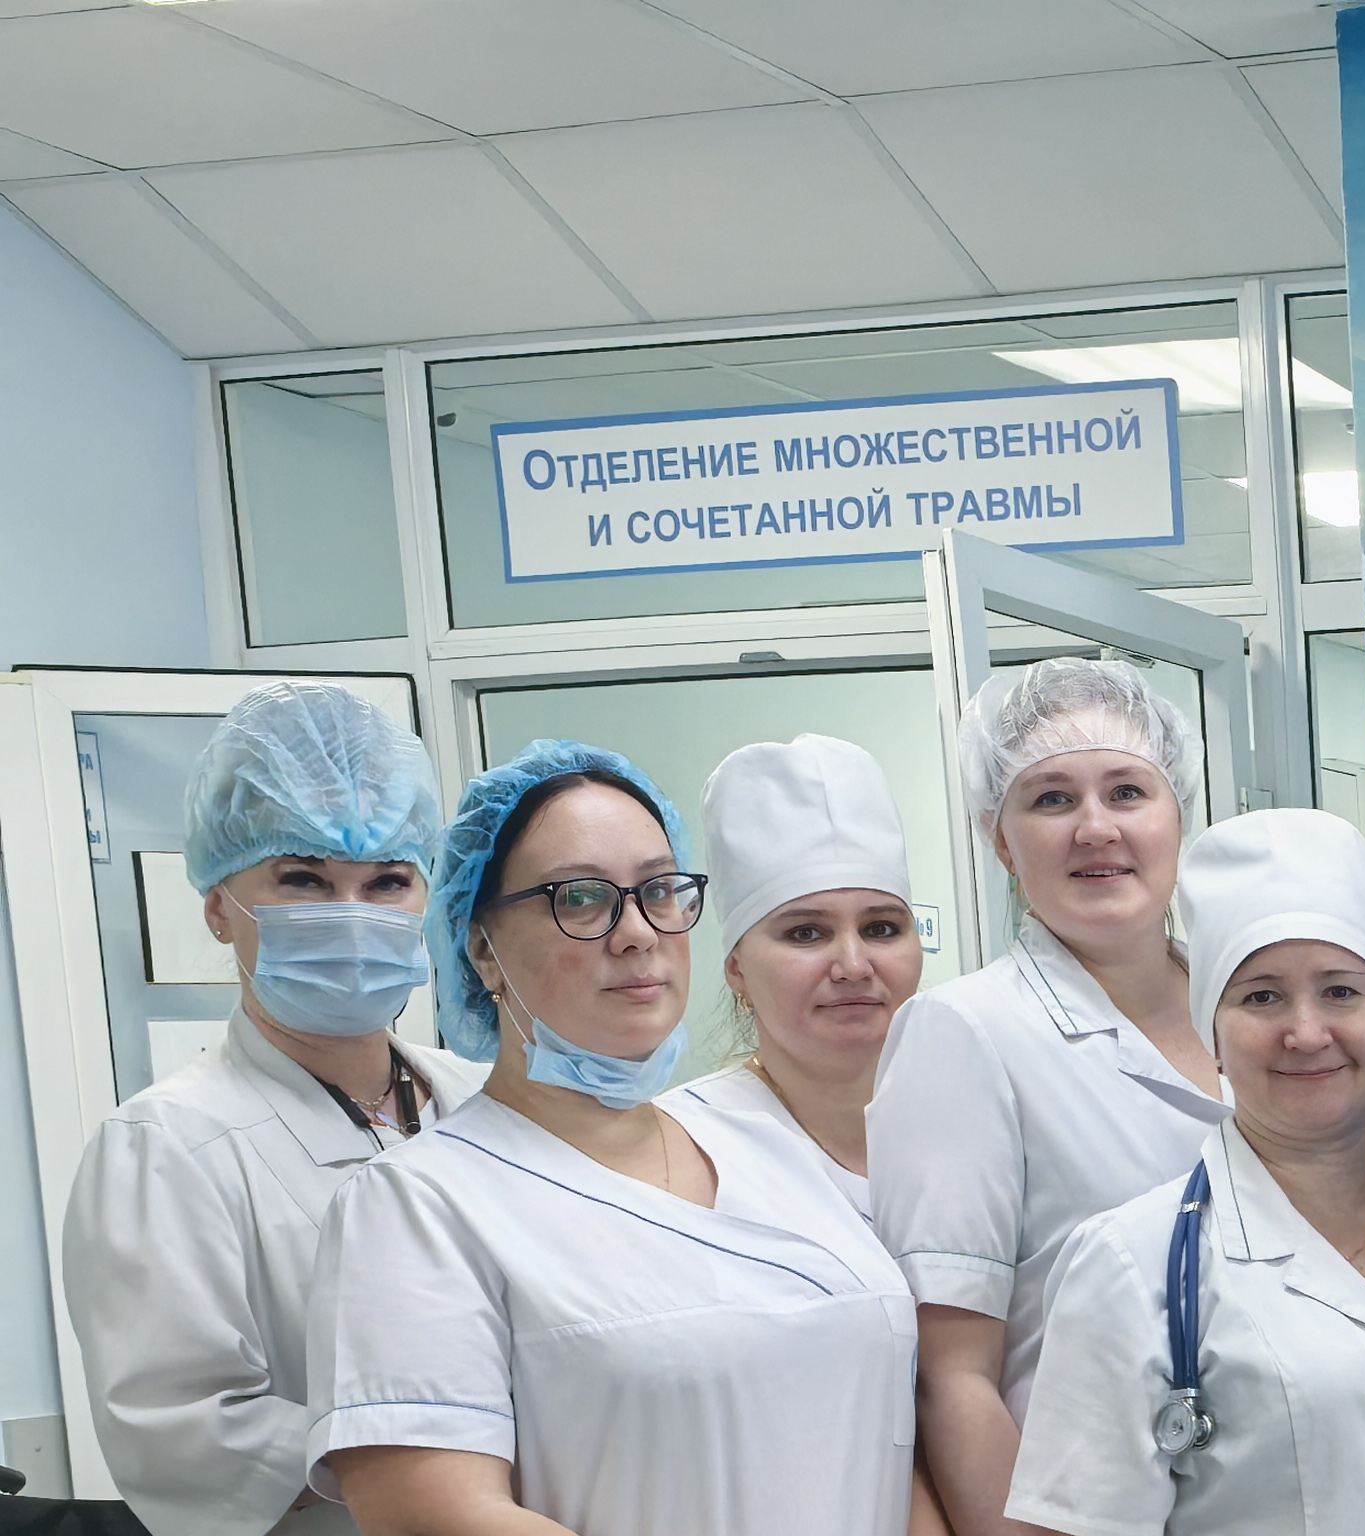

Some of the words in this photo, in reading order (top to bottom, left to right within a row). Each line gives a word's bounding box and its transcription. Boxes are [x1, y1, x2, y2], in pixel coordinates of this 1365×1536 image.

[523, 441, 759, 493] ОТДЕЛЕНИЕ
[774, 408, 1142, 473] МНОЖЕСТВЕННОЙ
[588, 514, 612, 547] И
[627, 487, 892, 543] СОЧЕТАННОЙ
[906, 483, 1082, 525] ТРАВМЫ
